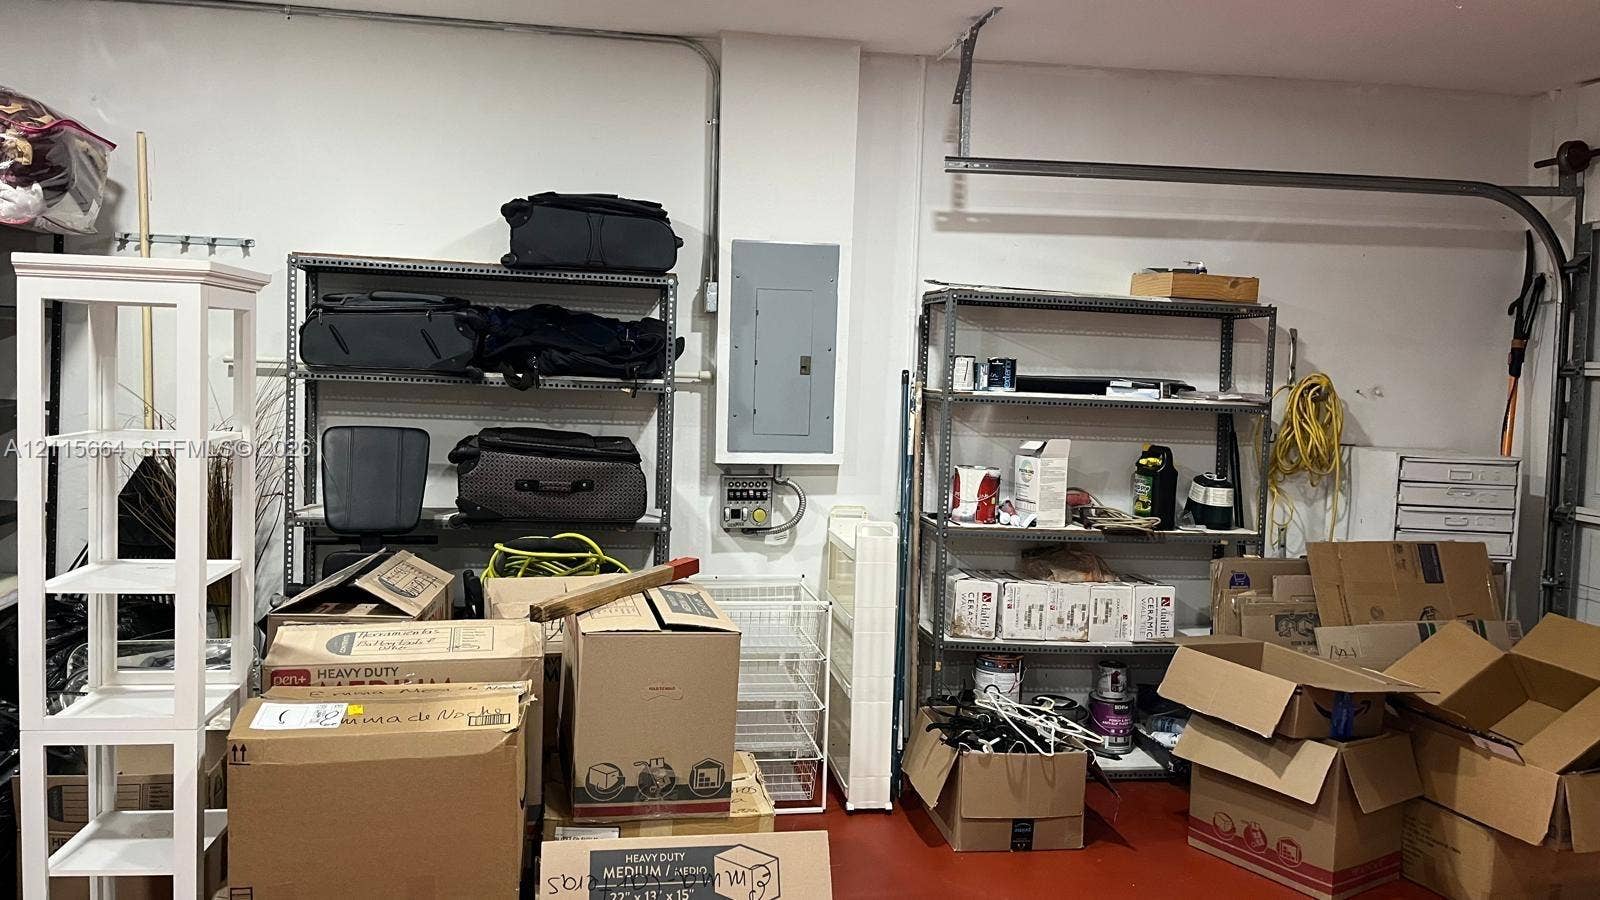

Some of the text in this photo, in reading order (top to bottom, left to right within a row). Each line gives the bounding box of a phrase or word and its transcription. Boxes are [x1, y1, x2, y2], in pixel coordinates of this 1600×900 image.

[1146, 597, 1155, 638] CERAMIC
[317, 666, 399, 680] HEAVY DUTY
[408, 711, 430, 722] de
[625, 852, 685, 864] HEAVY DUTY
[603, 865, 661, 880] MEDIUM
